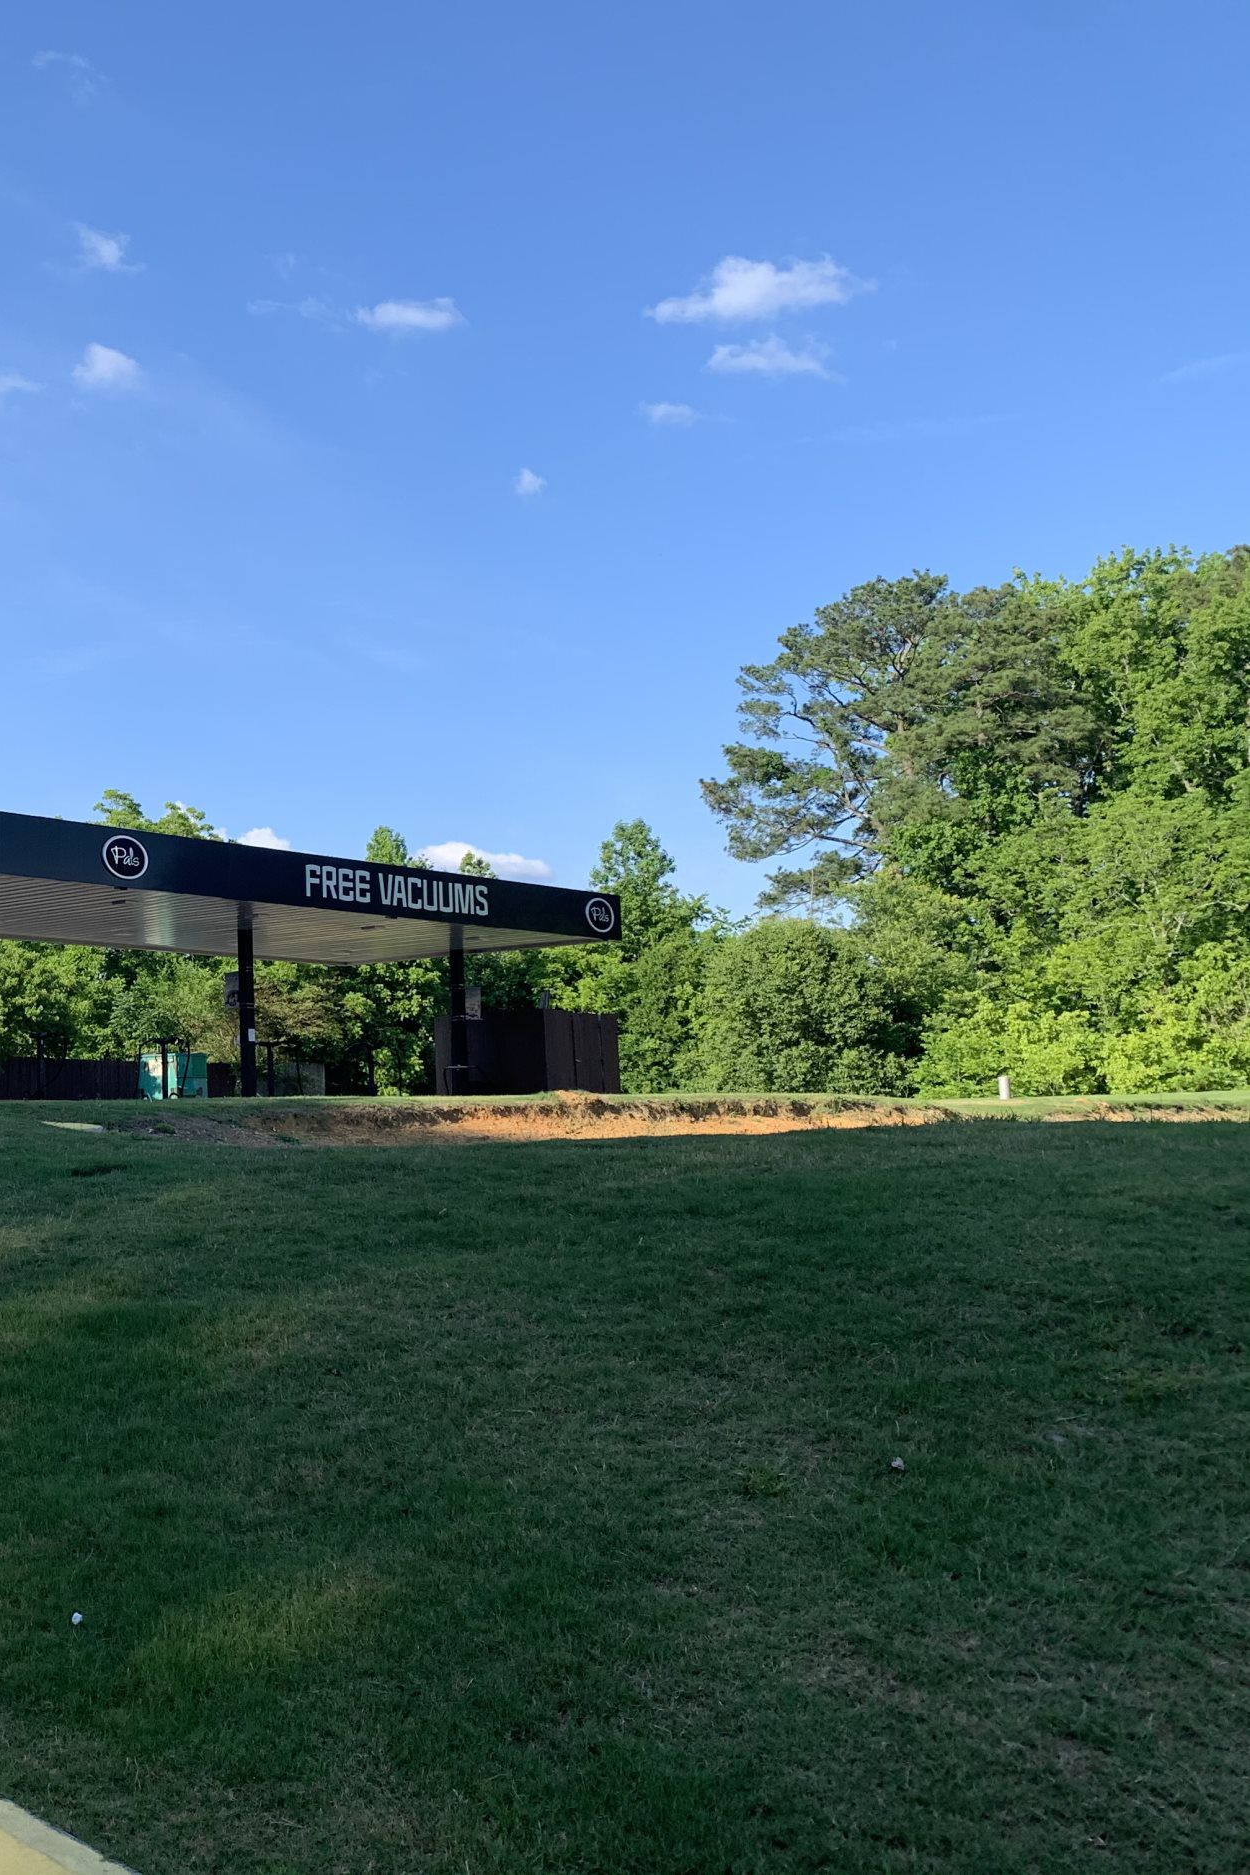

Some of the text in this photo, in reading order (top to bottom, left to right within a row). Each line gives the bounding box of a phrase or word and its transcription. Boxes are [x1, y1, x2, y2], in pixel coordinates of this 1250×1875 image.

[110, 845, 139, 867] Pals
[305, 864, 489, 916] FREE VACUUMS
